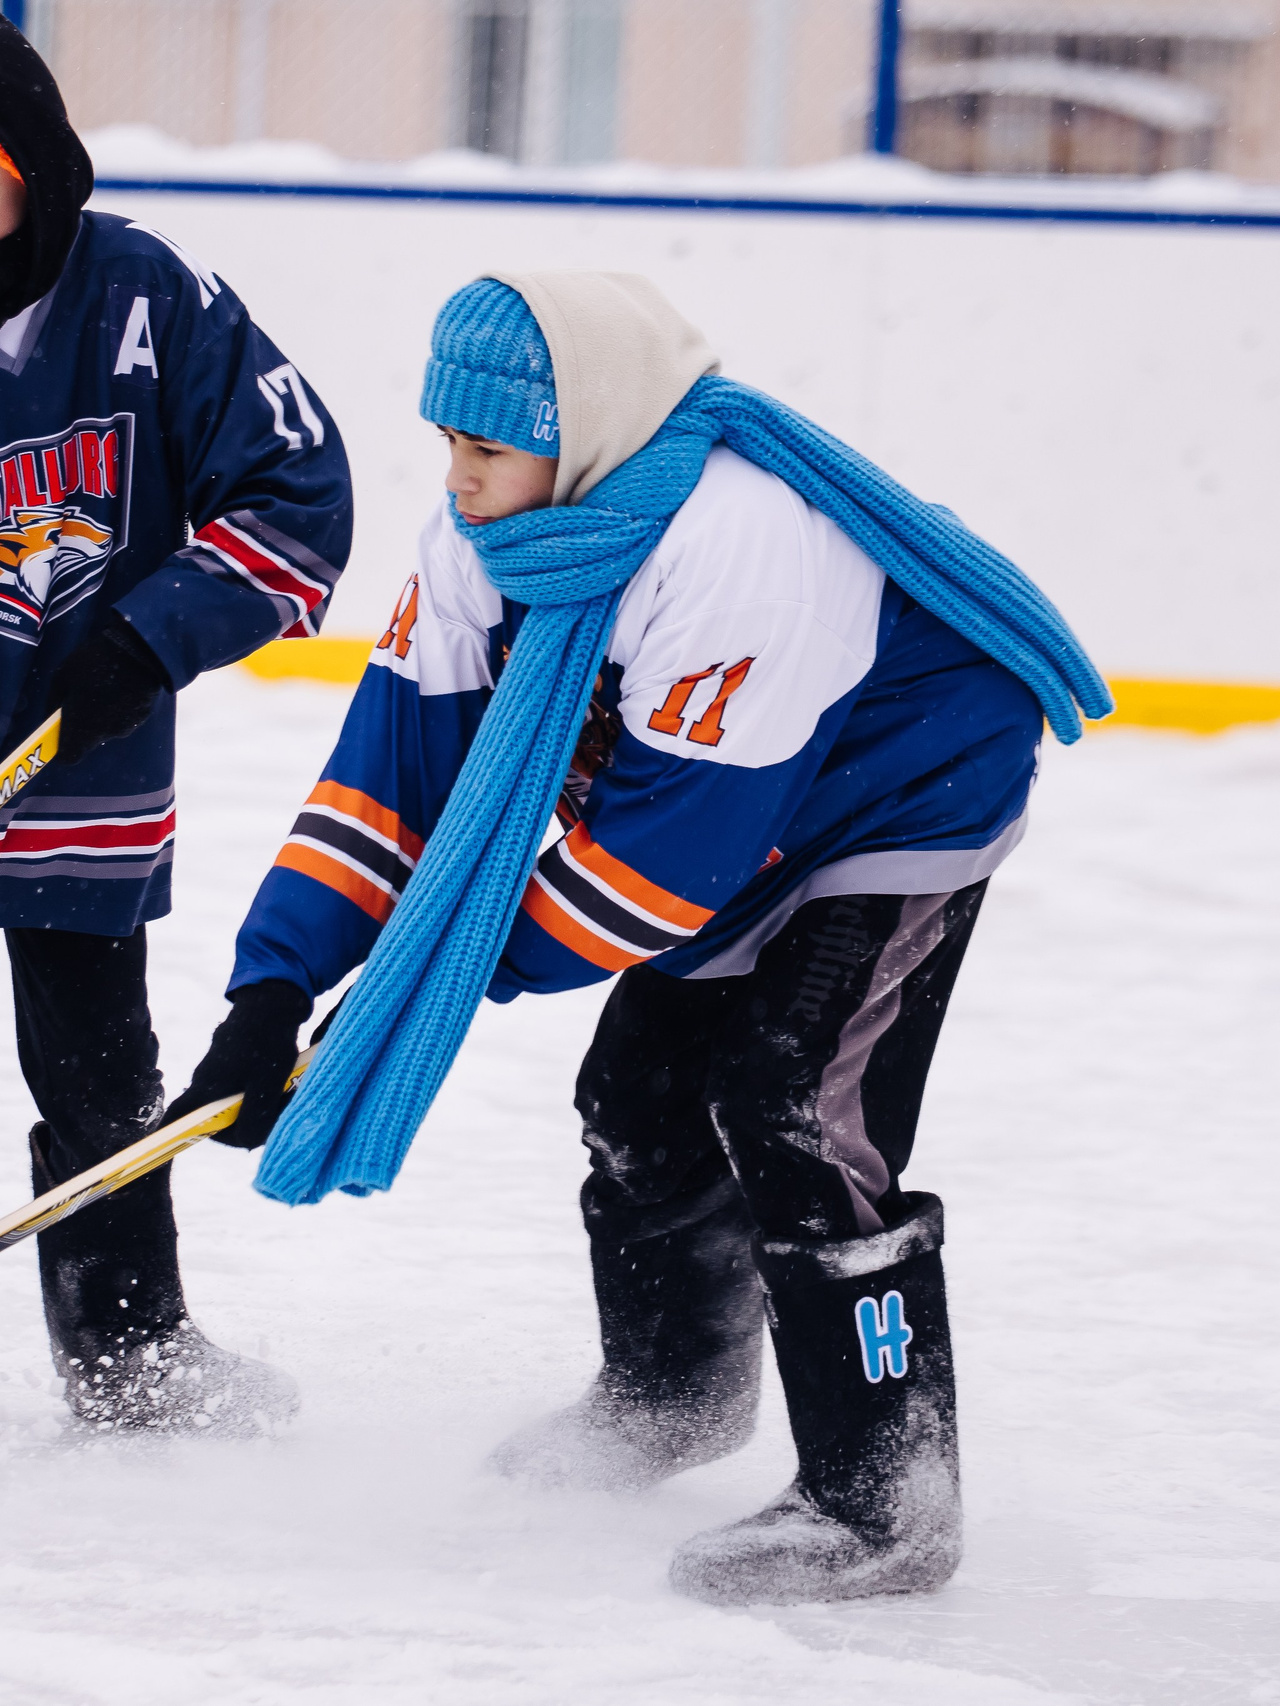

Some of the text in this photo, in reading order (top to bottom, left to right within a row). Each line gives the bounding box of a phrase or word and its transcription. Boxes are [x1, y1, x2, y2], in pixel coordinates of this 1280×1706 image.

[113, 296, 158, 379] A
[257, 362, 324, 450] 17
[647, 656, 756, 747] 11
